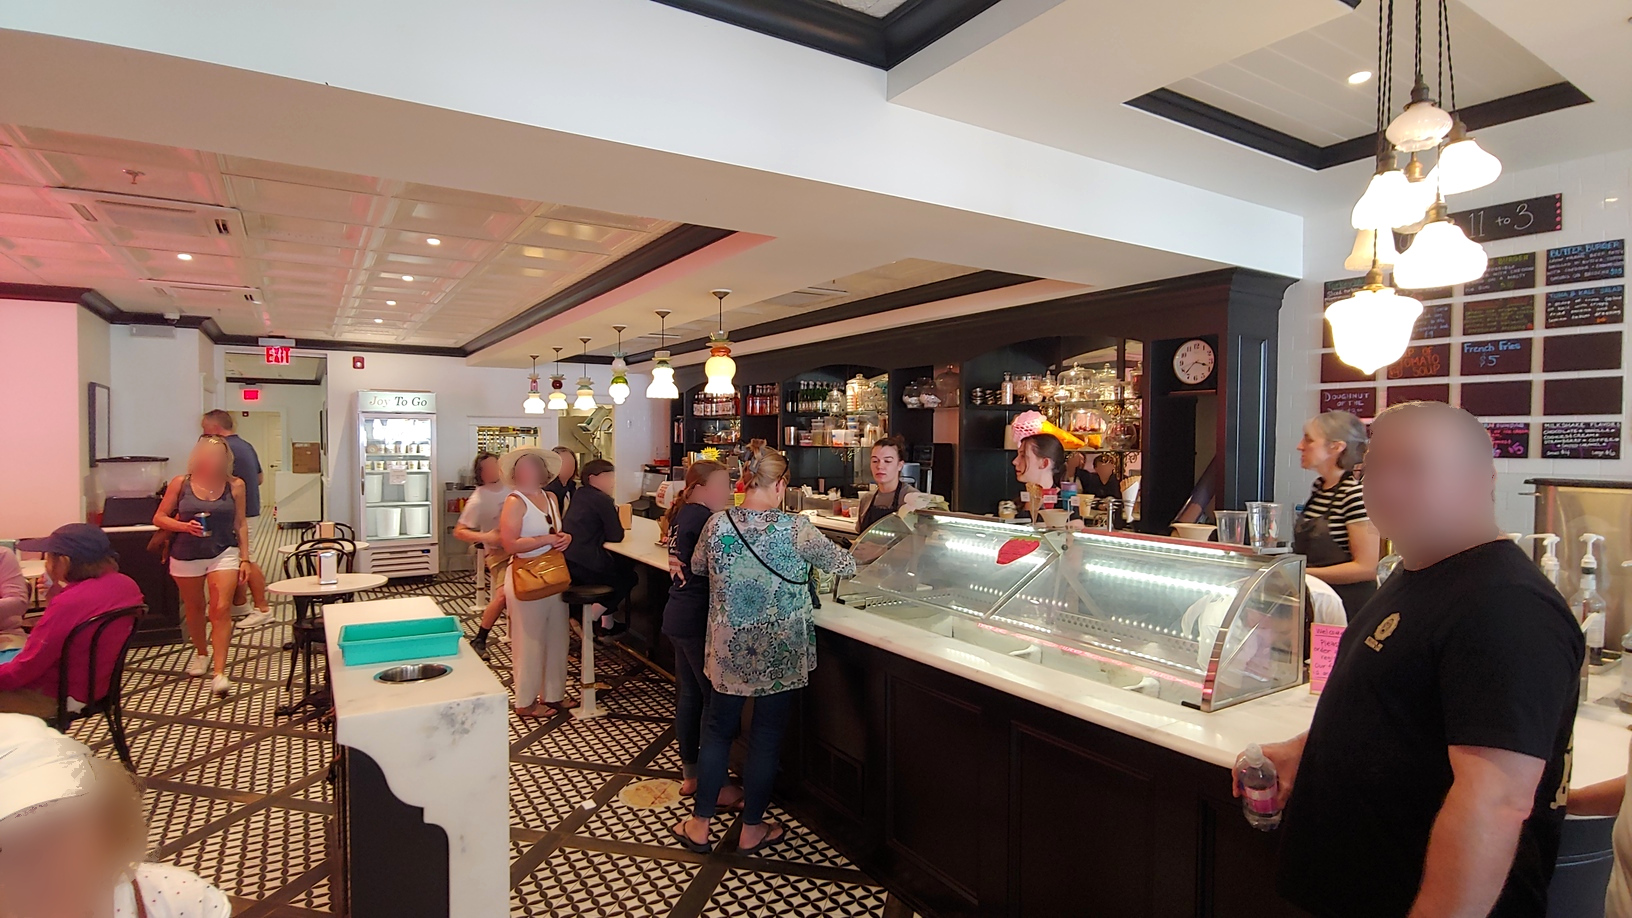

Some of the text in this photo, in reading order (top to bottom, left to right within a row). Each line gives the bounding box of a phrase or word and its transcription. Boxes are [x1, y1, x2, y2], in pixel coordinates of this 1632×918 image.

[1468, 203, 1534, 238] 11 to 3
[1550, 240, 1619, 258] BUTTER BURGER
[1498, 255, 1529, 265] BURGER
[1463, 340, 1521, 353] French Fries
[265, 346, 290, 363] EXIT
[1480, 353, 1500, 367] $5
[1412, 364, 1440, 376] SOUP
[369, 396, 427, 407] Joy To Go
